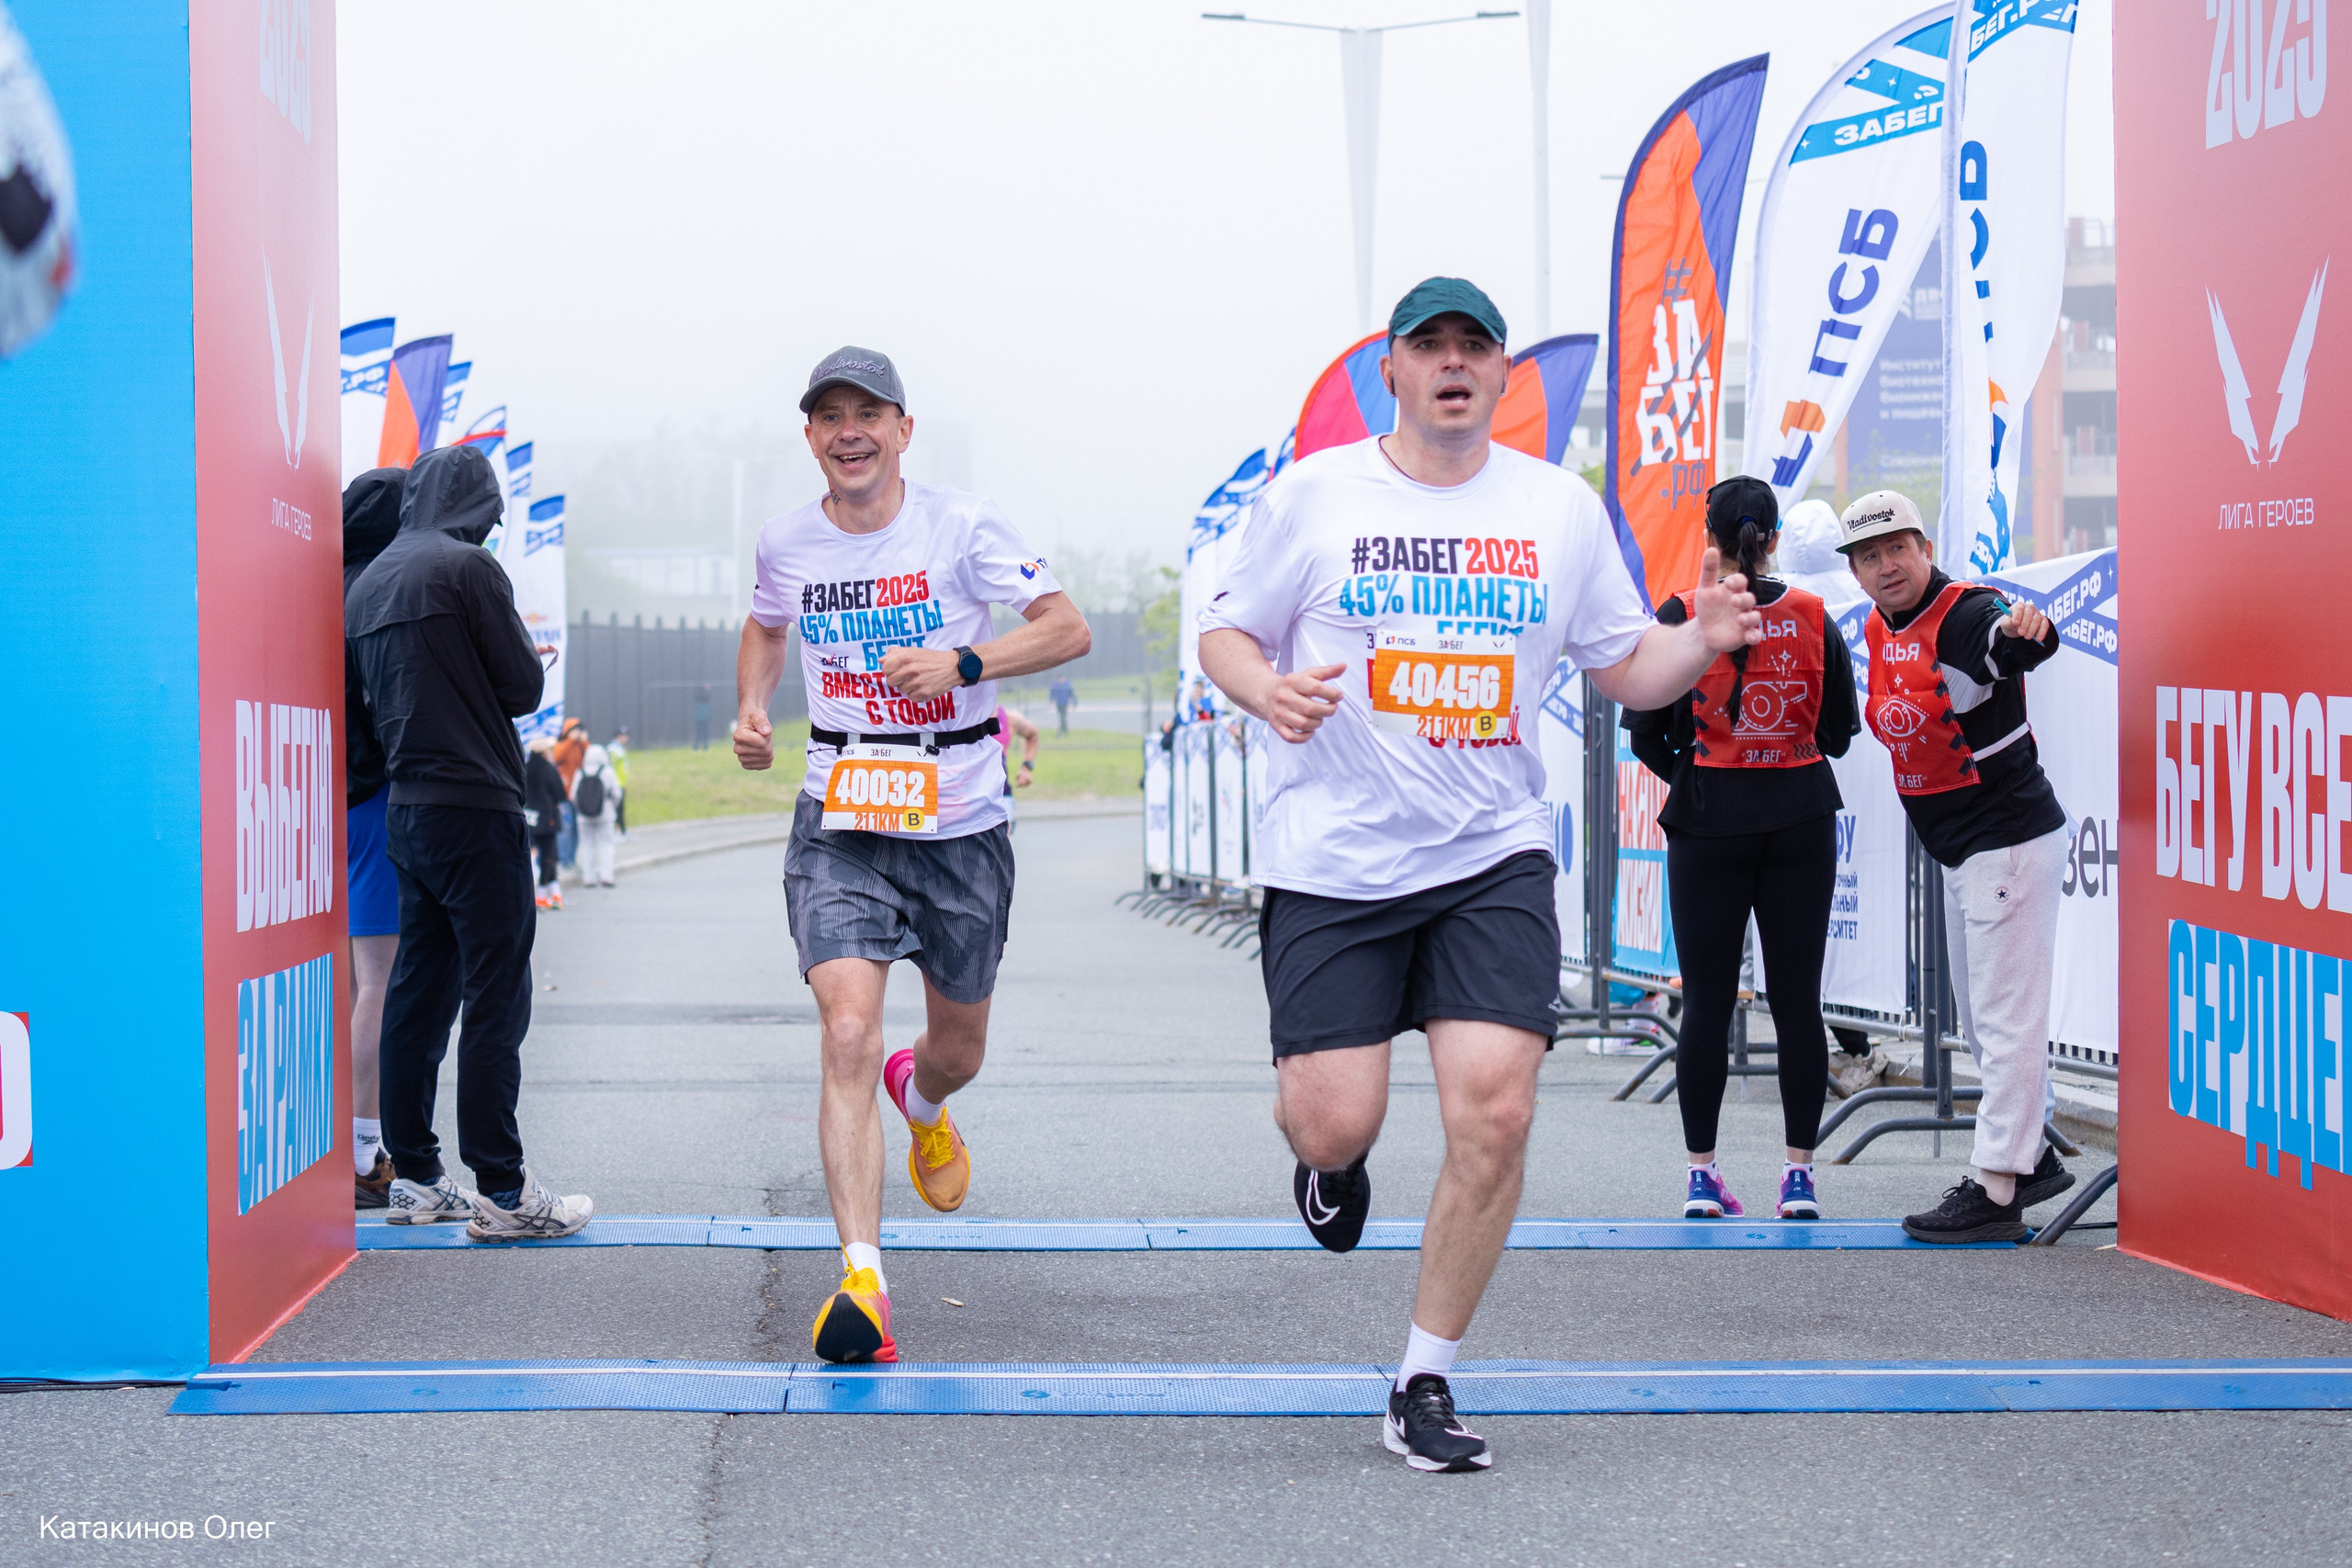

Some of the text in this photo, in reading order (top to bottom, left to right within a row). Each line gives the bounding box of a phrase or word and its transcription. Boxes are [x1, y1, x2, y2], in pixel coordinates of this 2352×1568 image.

[2205, 0, 2328, 150] 2025
[1808, 208, 1899, 378] ПСБ
[271, 497, 312, 541] ЛИГА ГЕРОЕВ
[1847, 508, 1895, 530] Vladivostok
[2218, 498, 2314, 530] ЛИГА ГЕРОЕВ
[841, 600, 944, 642] ПЛАНЕТЫ
[1339, 574, 1547, 626] 45% ПЛАНЕТЫ
[1397, 637, 1416, 646] ПСБ
[1388, 661, 1501, 710] 40456
[865, 700, 884, 725] С
[835, 768, 925, 807] 40032
[2156, 685, 2253, 892] БЕГУ
[235, 699, 333, 933] ВЫБЕГАЮ
[2169, 919, 2352, 1190] СЕРДЦЕ
[238, 977, 267, 1215] ЗА
[275, 952, 334, 1191] РАМКИ
